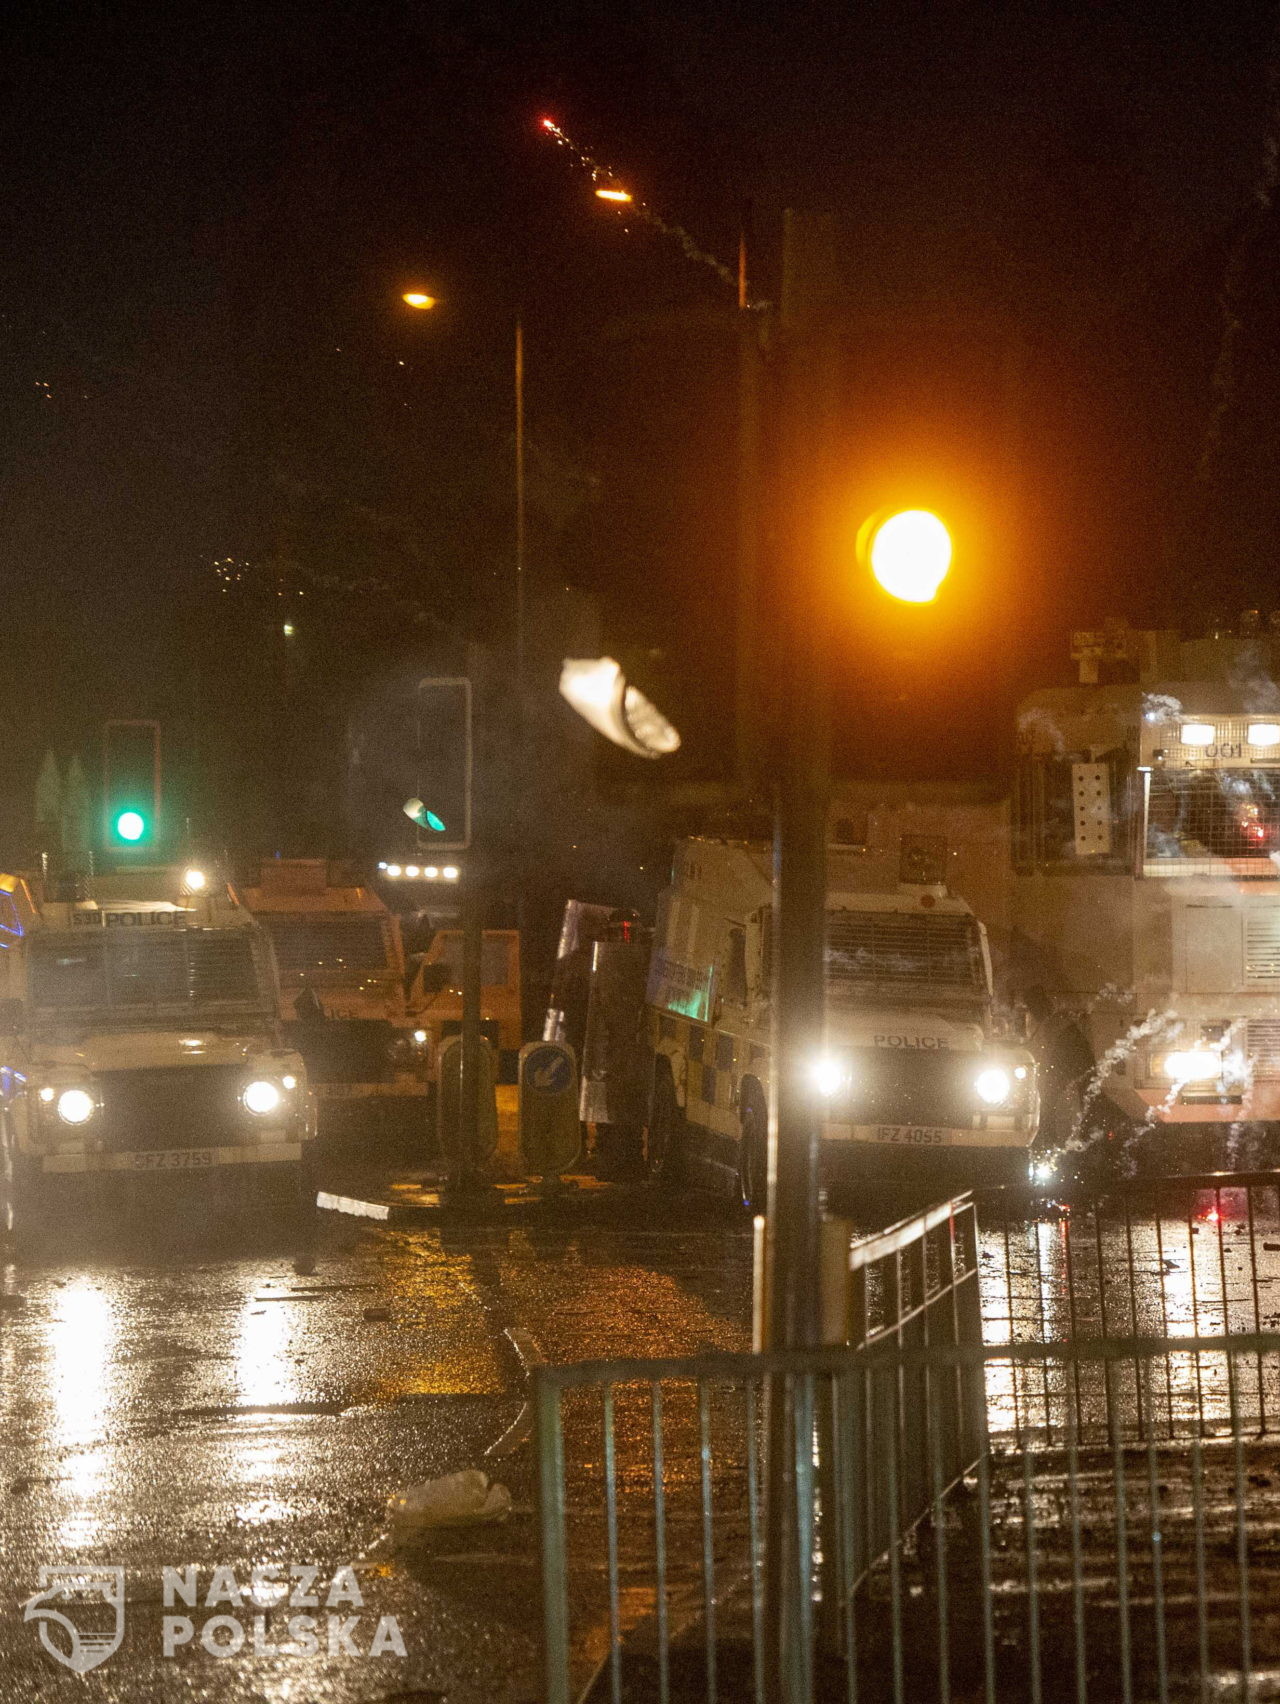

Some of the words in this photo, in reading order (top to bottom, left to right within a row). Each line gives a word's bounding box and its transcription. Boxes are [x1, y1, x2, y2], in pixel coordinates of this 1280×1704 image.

[106, 911, 187, 928] POLICE
[874, 1035, 949, 1049] POLICE
[171, 1151, 213, 1168] 3759
